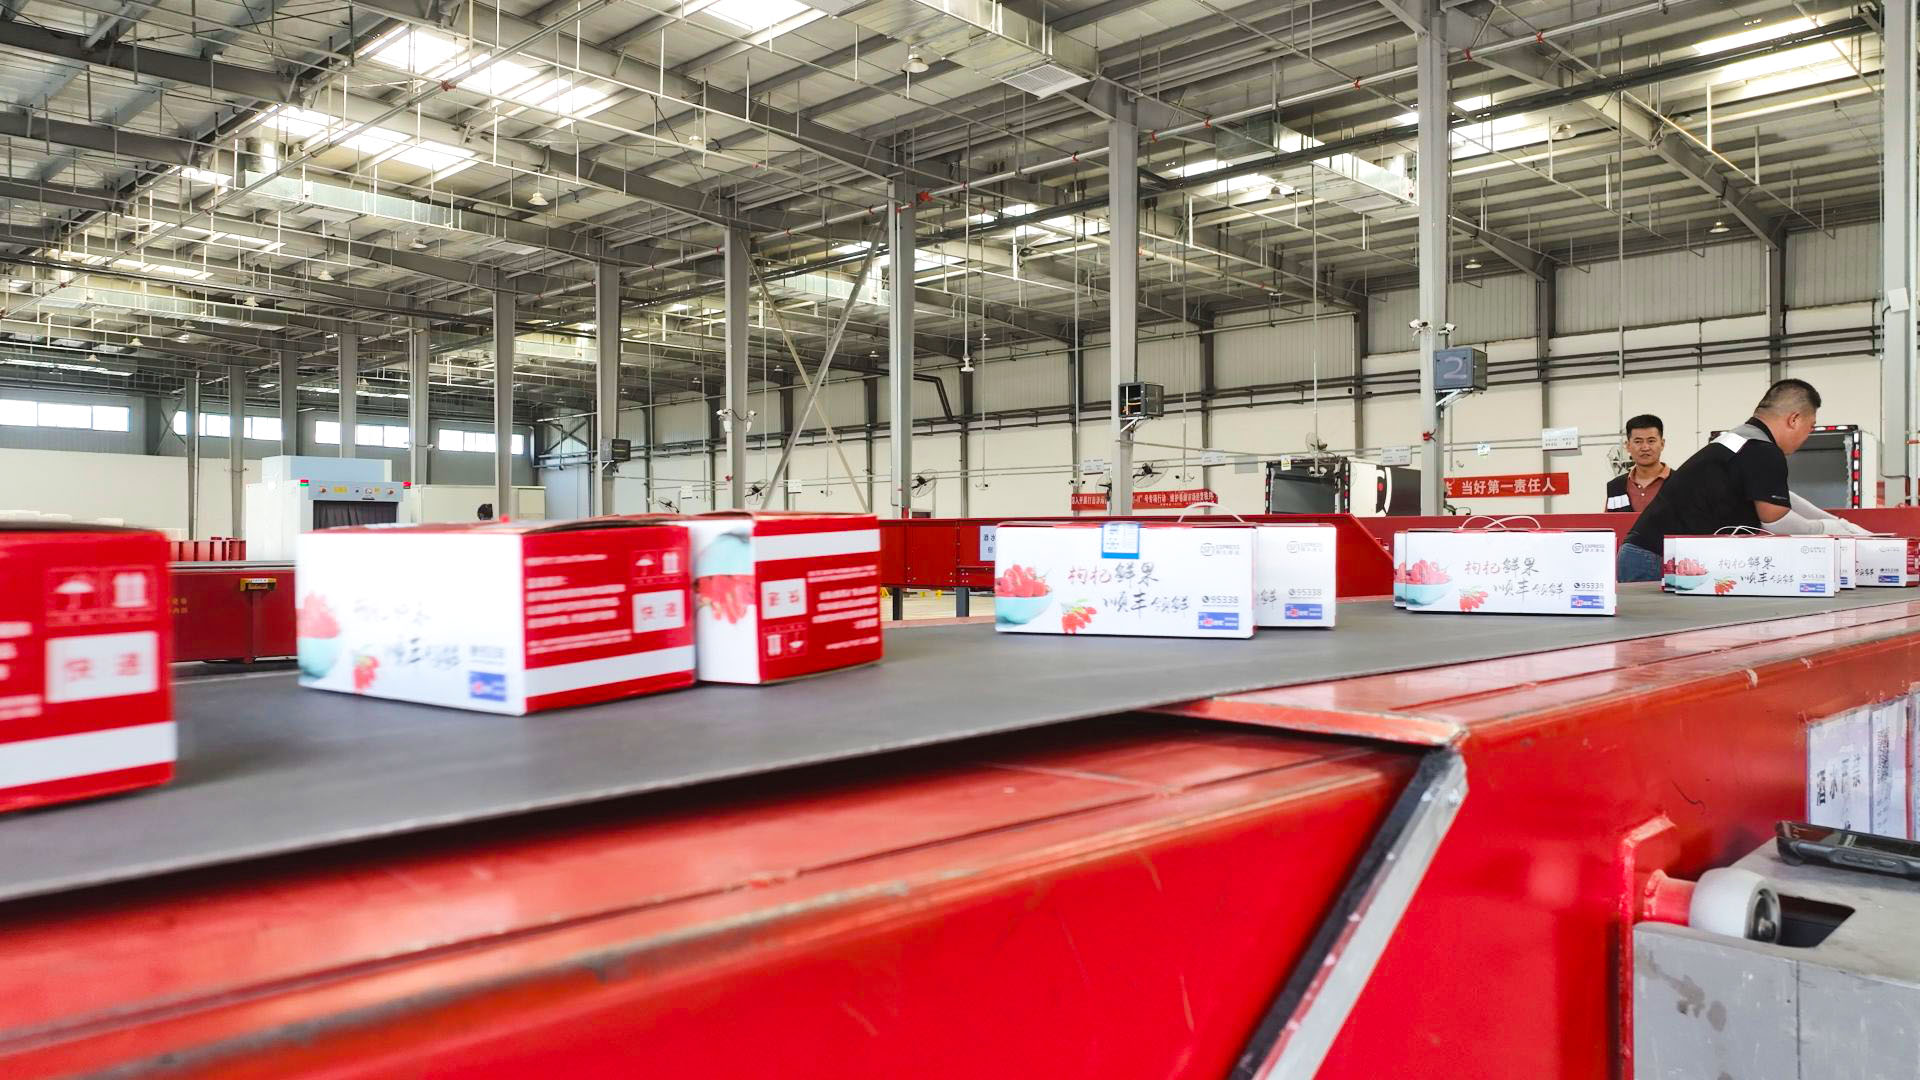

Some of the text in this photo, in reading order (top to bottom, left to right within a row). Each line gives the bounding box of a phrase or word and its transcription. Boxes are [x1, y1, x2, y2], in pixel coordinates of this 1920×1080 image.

[1443, 356, 1468, 380] 2
[1461, 477, 1556, 495] 当好第一责任人
